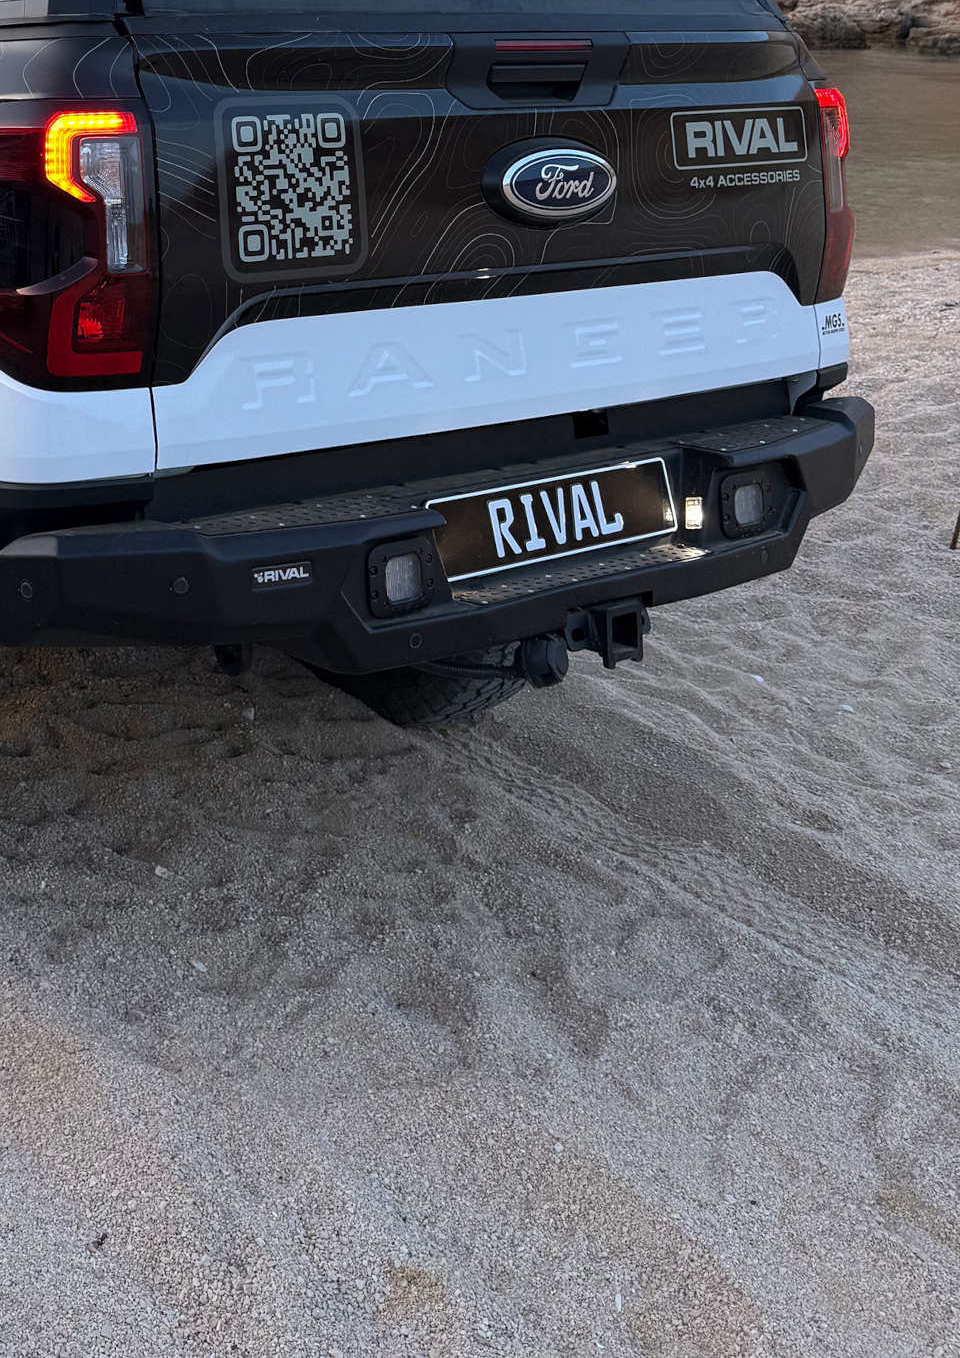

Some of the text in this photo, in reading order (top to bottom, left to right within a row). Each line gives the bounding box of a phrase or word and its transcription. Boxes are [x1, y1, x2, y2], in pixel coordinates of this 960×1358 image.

[685, 117, 798, 158] RIVAL
[535, 164, 594, 200] Ford
[690, 169, 800, 189] 4x4 ACCESSORIES
[488, 480, 624, 558] RIVAL
[264, 566, 309, 583] RIVAL
